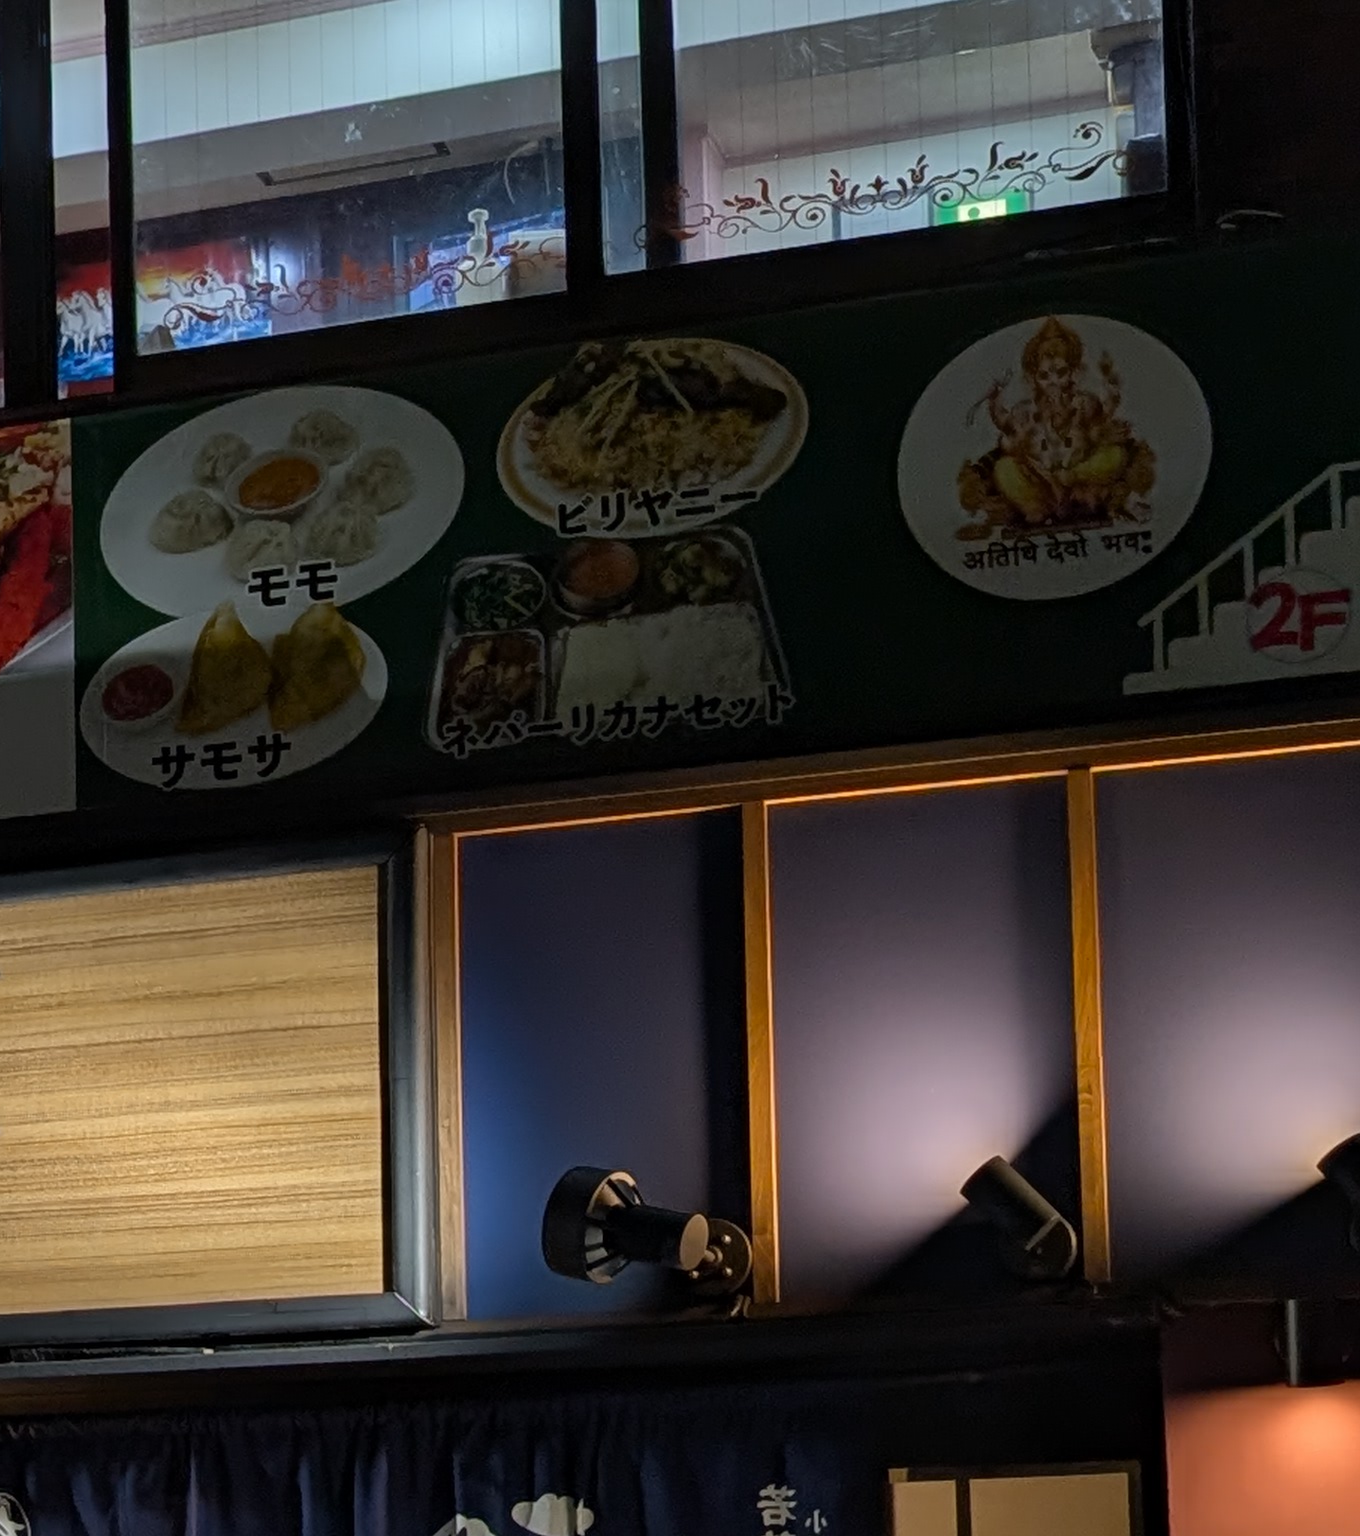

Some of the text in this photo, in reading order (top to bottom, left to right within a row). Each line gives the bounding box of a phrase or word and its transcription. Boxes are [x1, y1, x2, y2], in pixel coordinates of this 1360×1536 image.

[556, 486, 760, 538] ビリヤニー
[248, 562, 338, 607] モモ
[1250, 581, 1351, 653] 2F
[442, 682, 795, 758] ネパーリカナセット
[152, 735, 291, 788] サモサ
